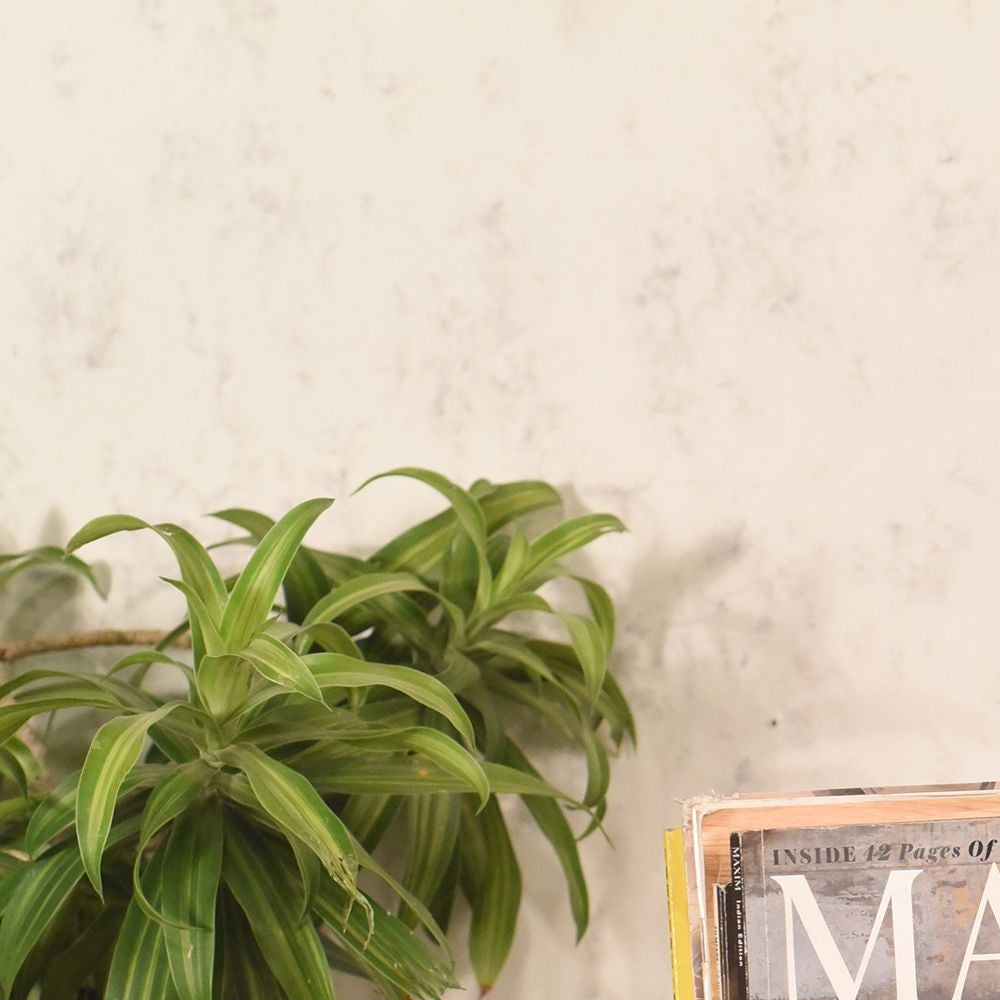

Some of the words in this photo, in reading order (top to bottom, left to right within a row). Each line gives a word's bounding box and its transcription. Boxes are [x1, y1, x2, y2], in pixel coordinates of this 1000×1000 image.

[733, 847, 742, 891] MAXIM
[772, 845, 856, 866] INSIDE
[863, 843, 892, 862] 42
[900, 842, 961, 864] Pages
[968, 838, 997, 862] Of
